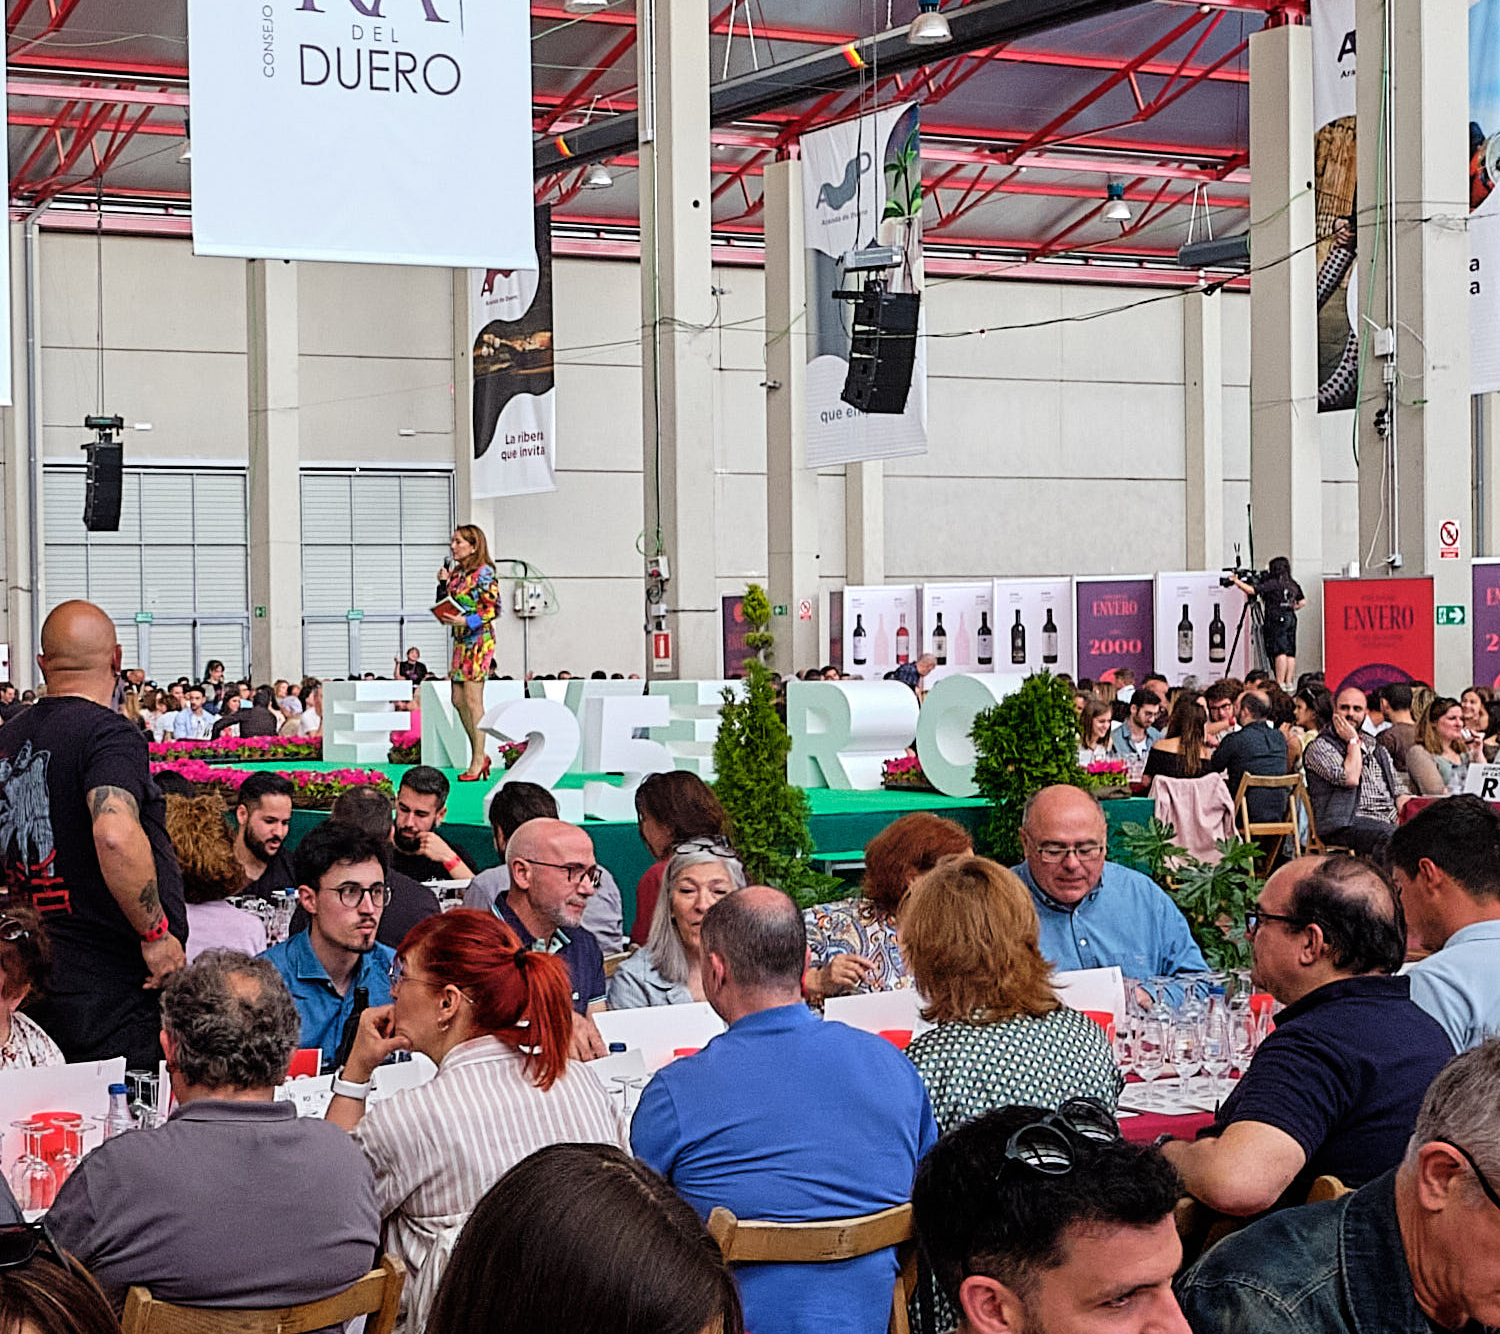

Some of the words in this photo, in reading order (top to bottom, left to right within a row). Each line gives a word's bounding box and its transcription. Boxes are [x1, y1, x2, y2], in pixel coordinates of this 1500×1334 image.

[262, 4, 275, 78] CONSEJO
[351, 23, 400, 45] DEL
[300, 44, 462, 97] DUERO
[820, 407, 842, 422] que
[505, 433, 516, 445] La
[501, 449, 517, 461] que
[519, 445, 546, 457] invita
[1343, 604, 1415, 632] ENVERO
[1089, 638, 1142, 655] 2000
[477, 695, 675, 824] 25
[1481, 777, 1499, 798] R
